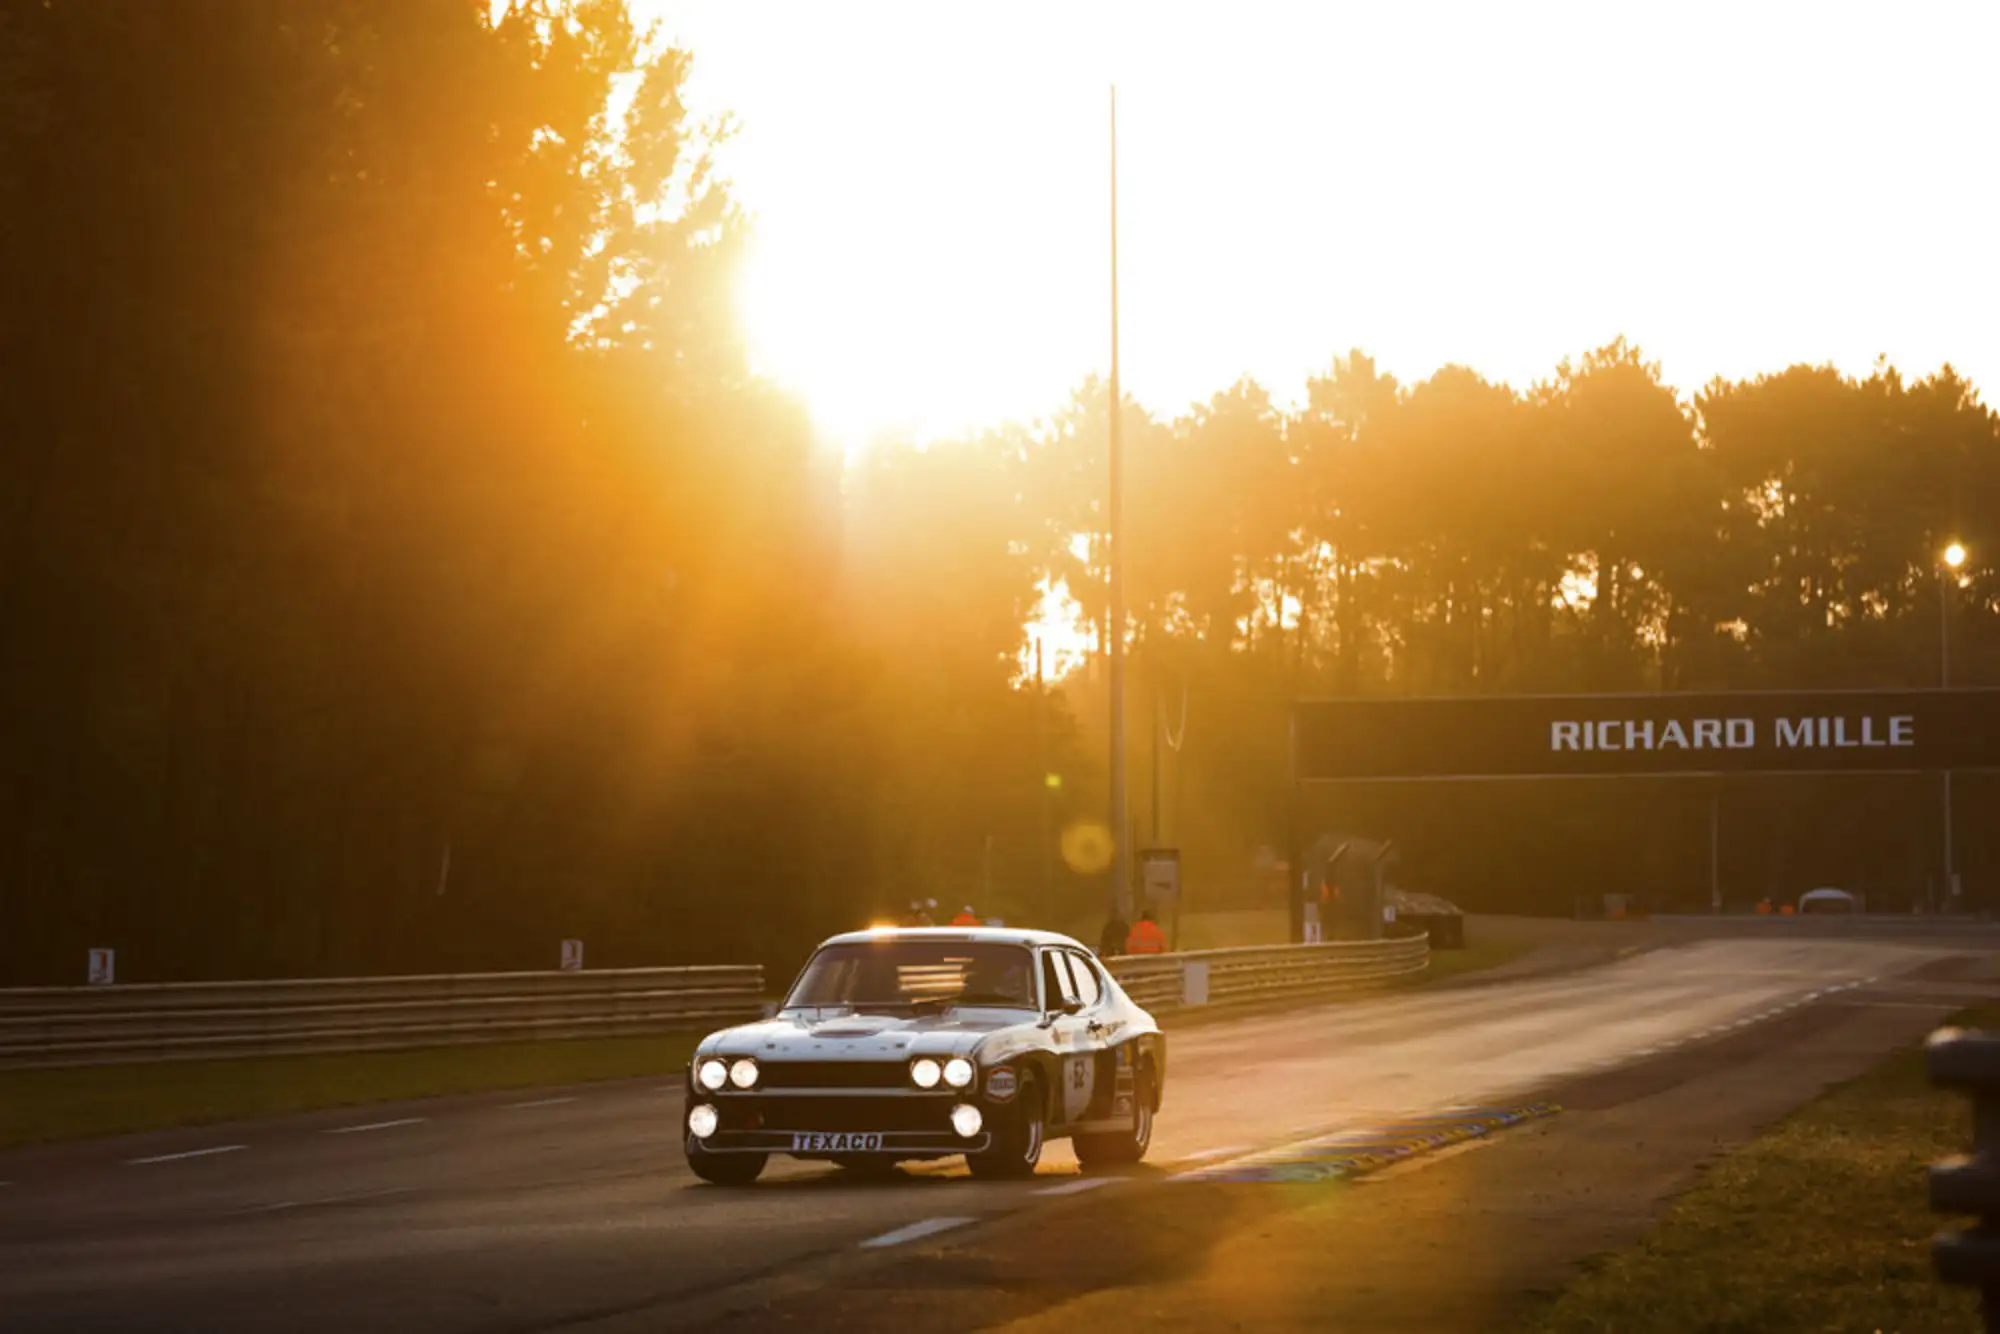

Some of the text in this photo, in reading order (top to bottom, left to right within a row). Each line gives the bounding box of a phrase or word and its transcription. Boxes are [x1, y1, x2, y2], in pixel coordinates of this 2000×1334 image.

[1550, 716, 1914, 750] RICHARD MILLE
[795, 1133, 880, 1150] TEXACO
